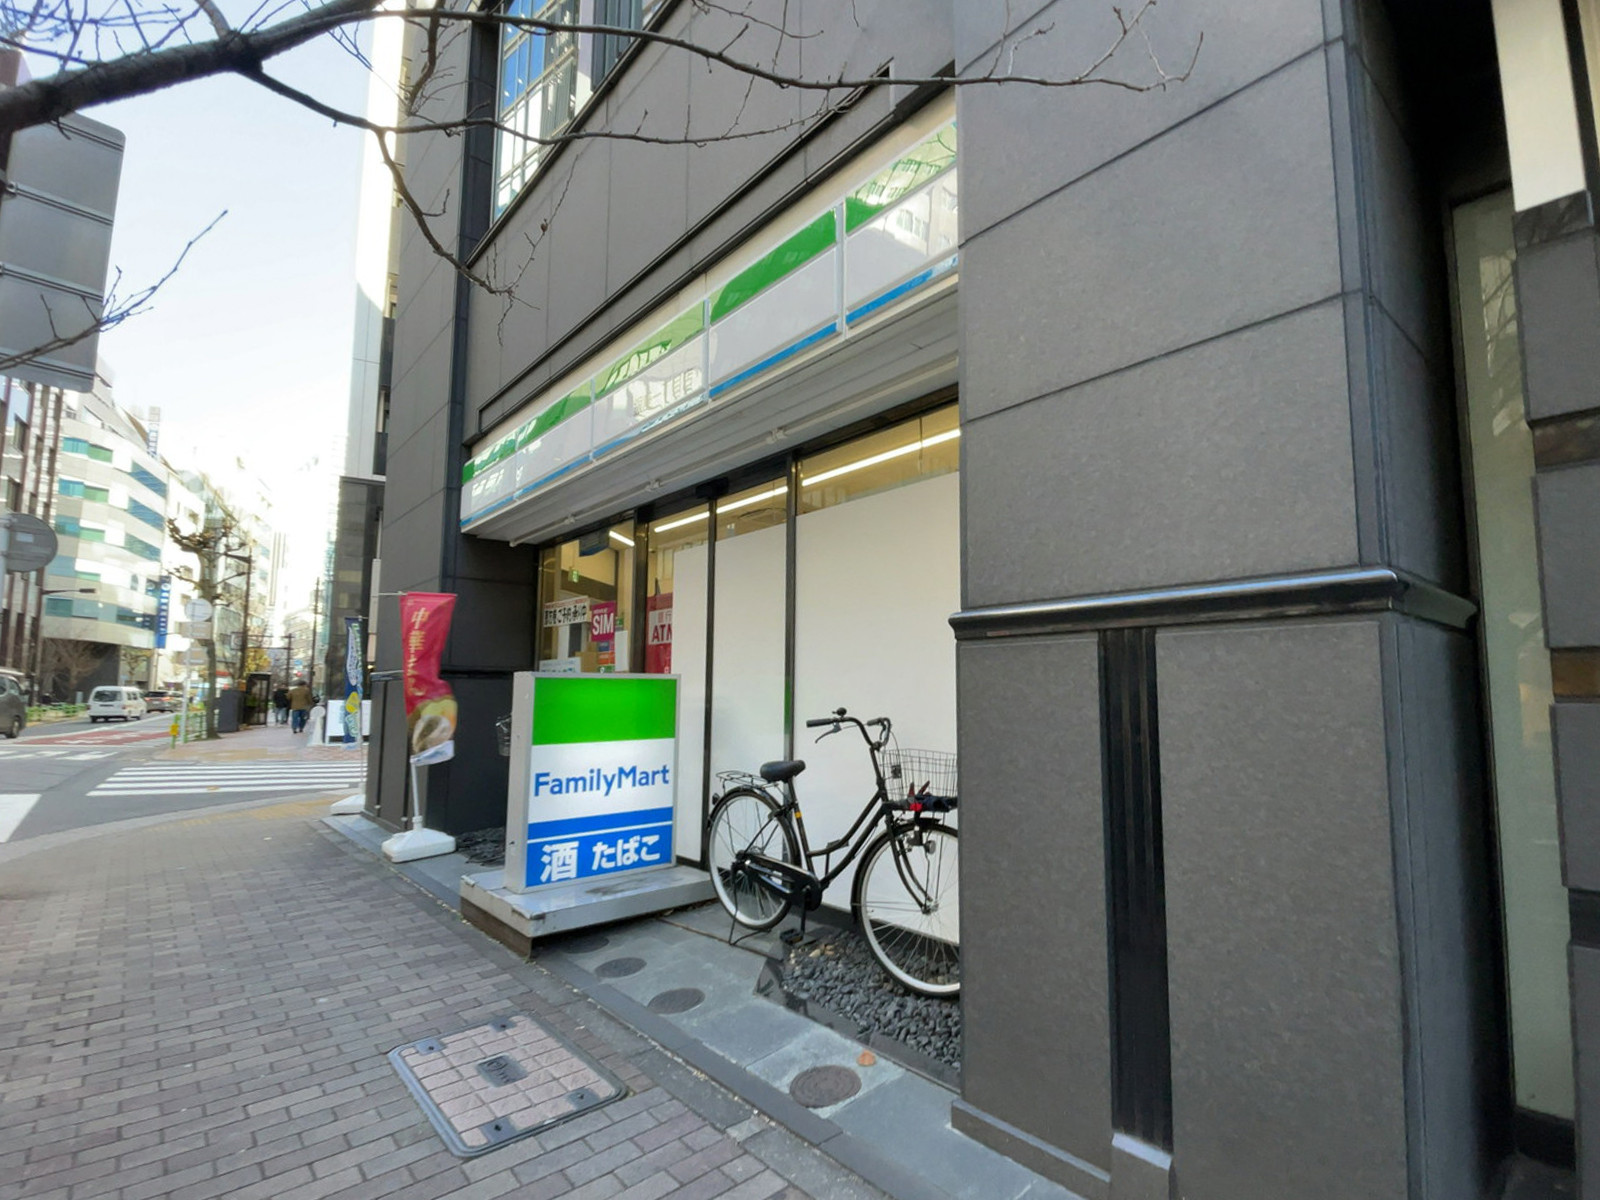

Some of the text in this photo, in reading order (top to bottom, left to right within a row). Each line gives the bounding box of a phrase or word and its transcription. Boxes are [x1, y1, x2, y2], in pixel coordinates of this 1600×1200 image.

[592, 612, 615, 635] SIM
[534, 764, 670, 797] FamilyMart
[540, 834, 661, 883] 酒 たばこ
